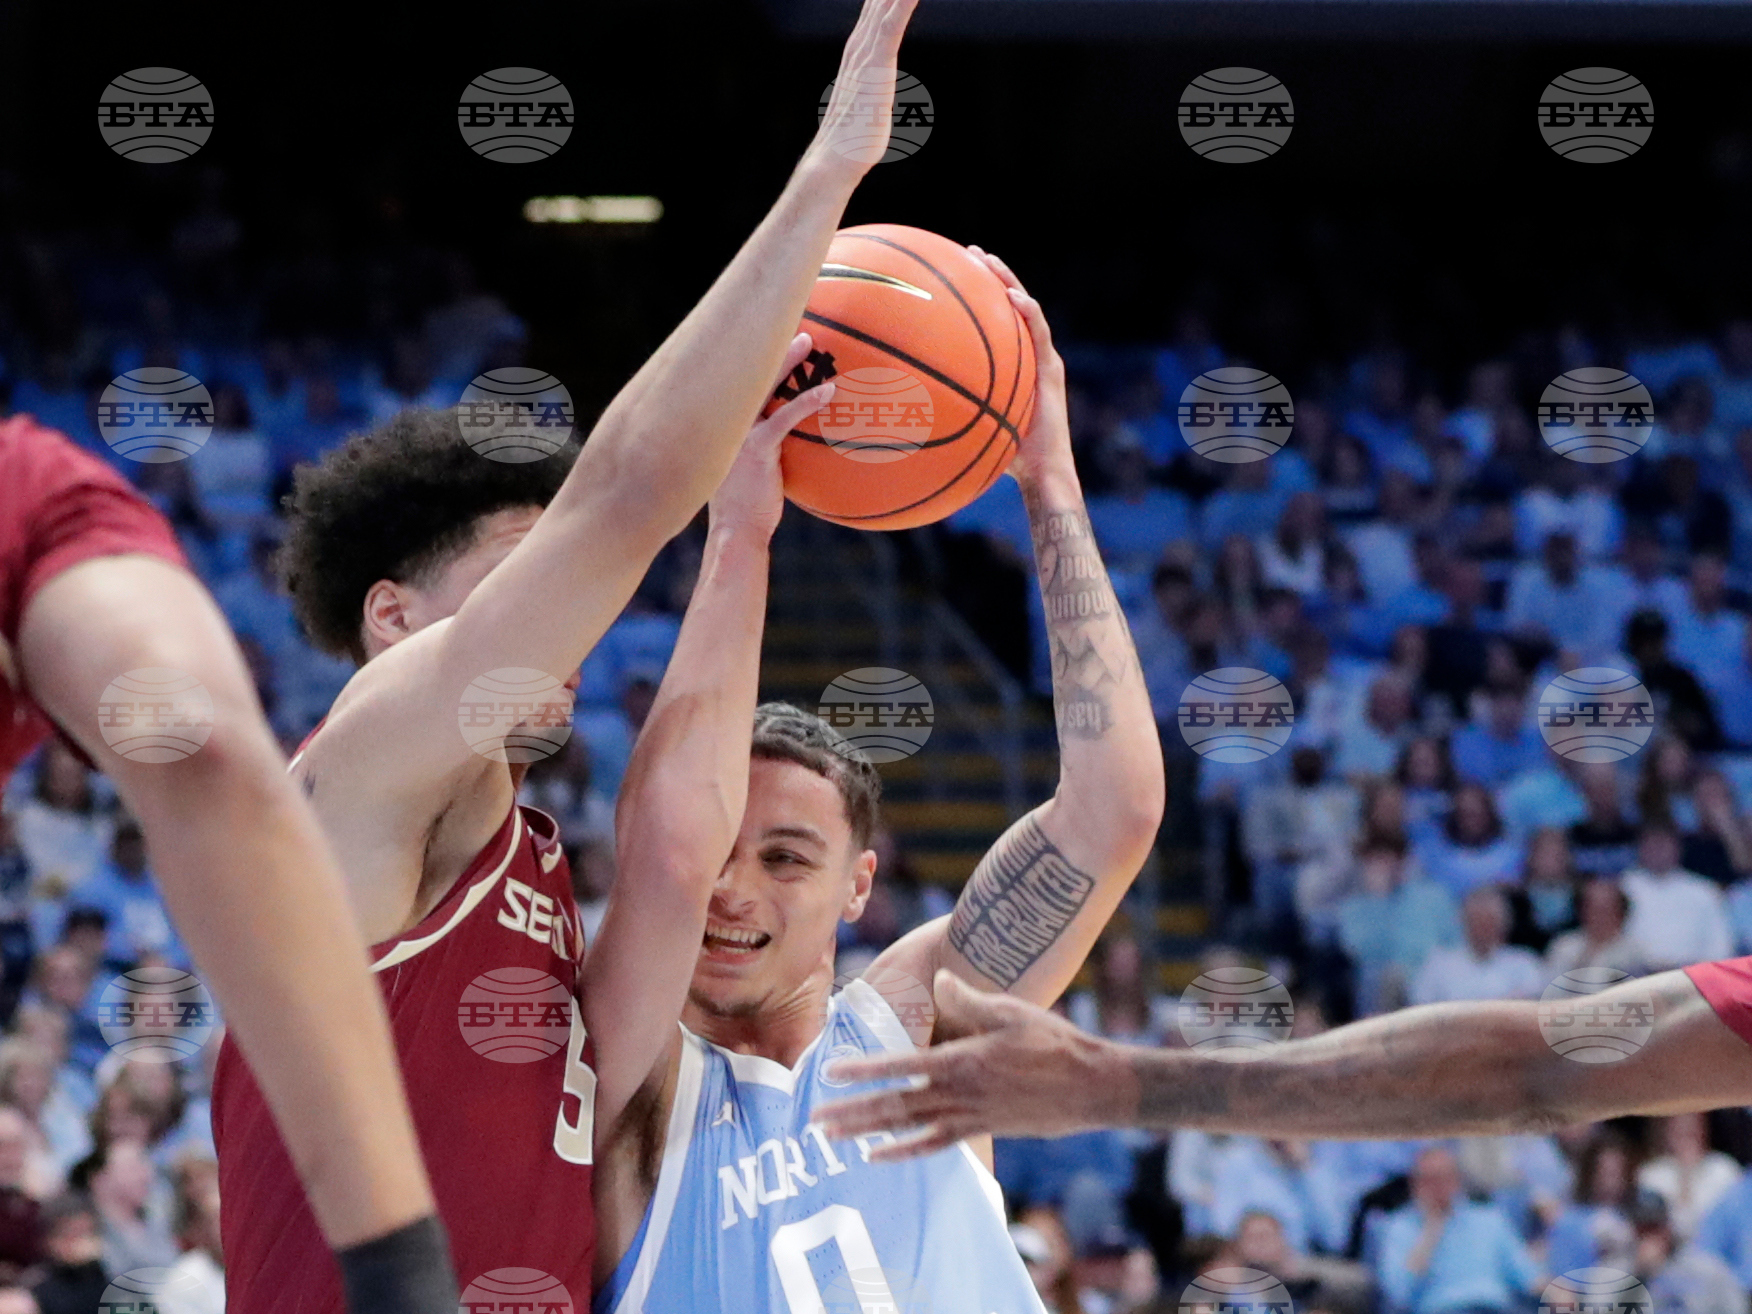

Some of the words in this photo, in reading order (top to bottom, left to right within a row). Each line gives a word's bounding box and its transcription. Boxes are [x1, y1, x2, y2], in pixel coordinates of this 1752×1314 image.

[963, 922, 1030, 989] FOR
[988, 852, 1091, 956] GRANTED
[553, 995, 598, 1165] 5
